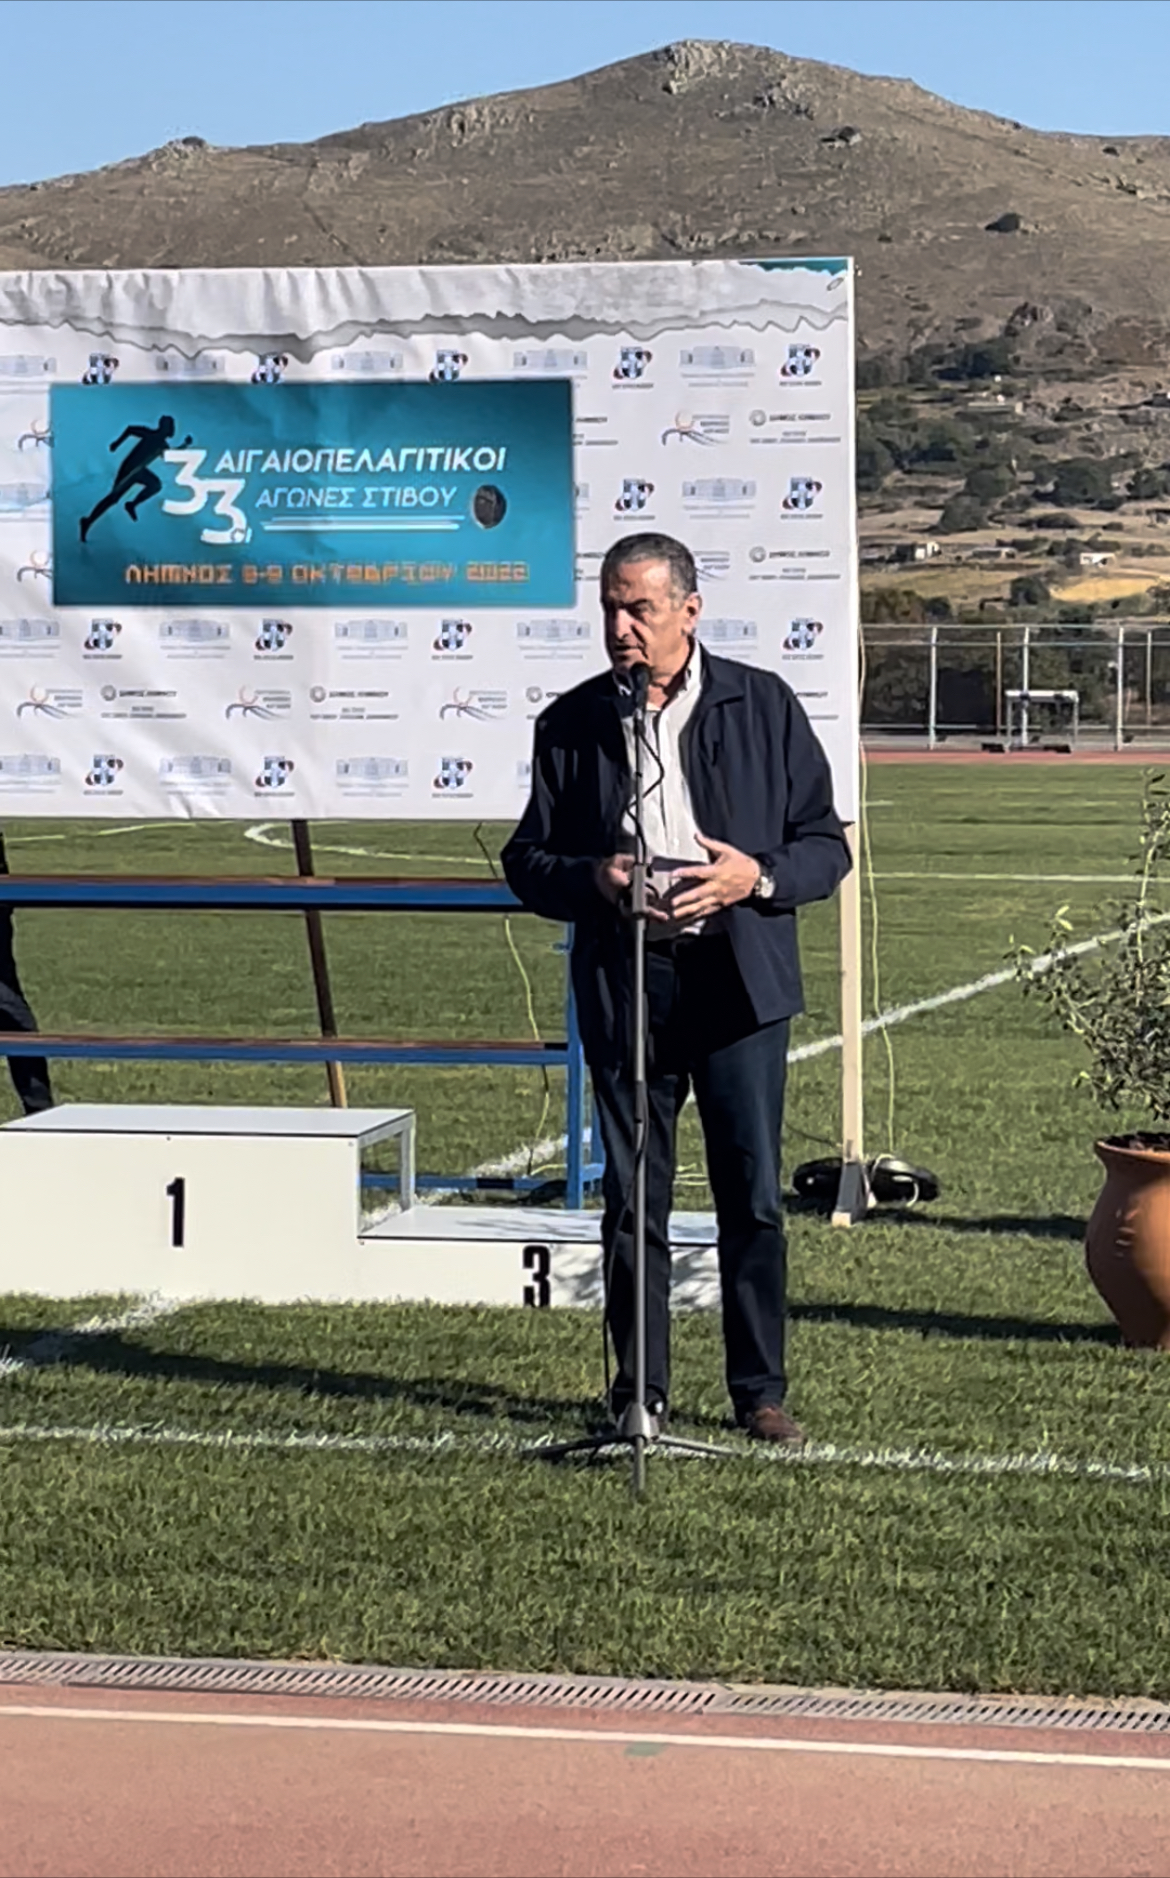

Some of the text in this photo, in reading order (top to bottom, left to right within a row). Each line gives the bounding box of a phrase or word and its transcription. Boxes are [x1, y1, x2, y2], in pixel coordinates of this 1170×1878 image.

[214, 447, 506, 473] ΑΙΓΑΙΟΠΕΛΑΓΙΤΙΚΟΙ
[255, 486, 457, 508] ΑΓΩΝΕΣ ΣΤΙΒΟΥ
[166, 1177, 185, 1247] 1
[522, 1245, 550, 1308] 3
